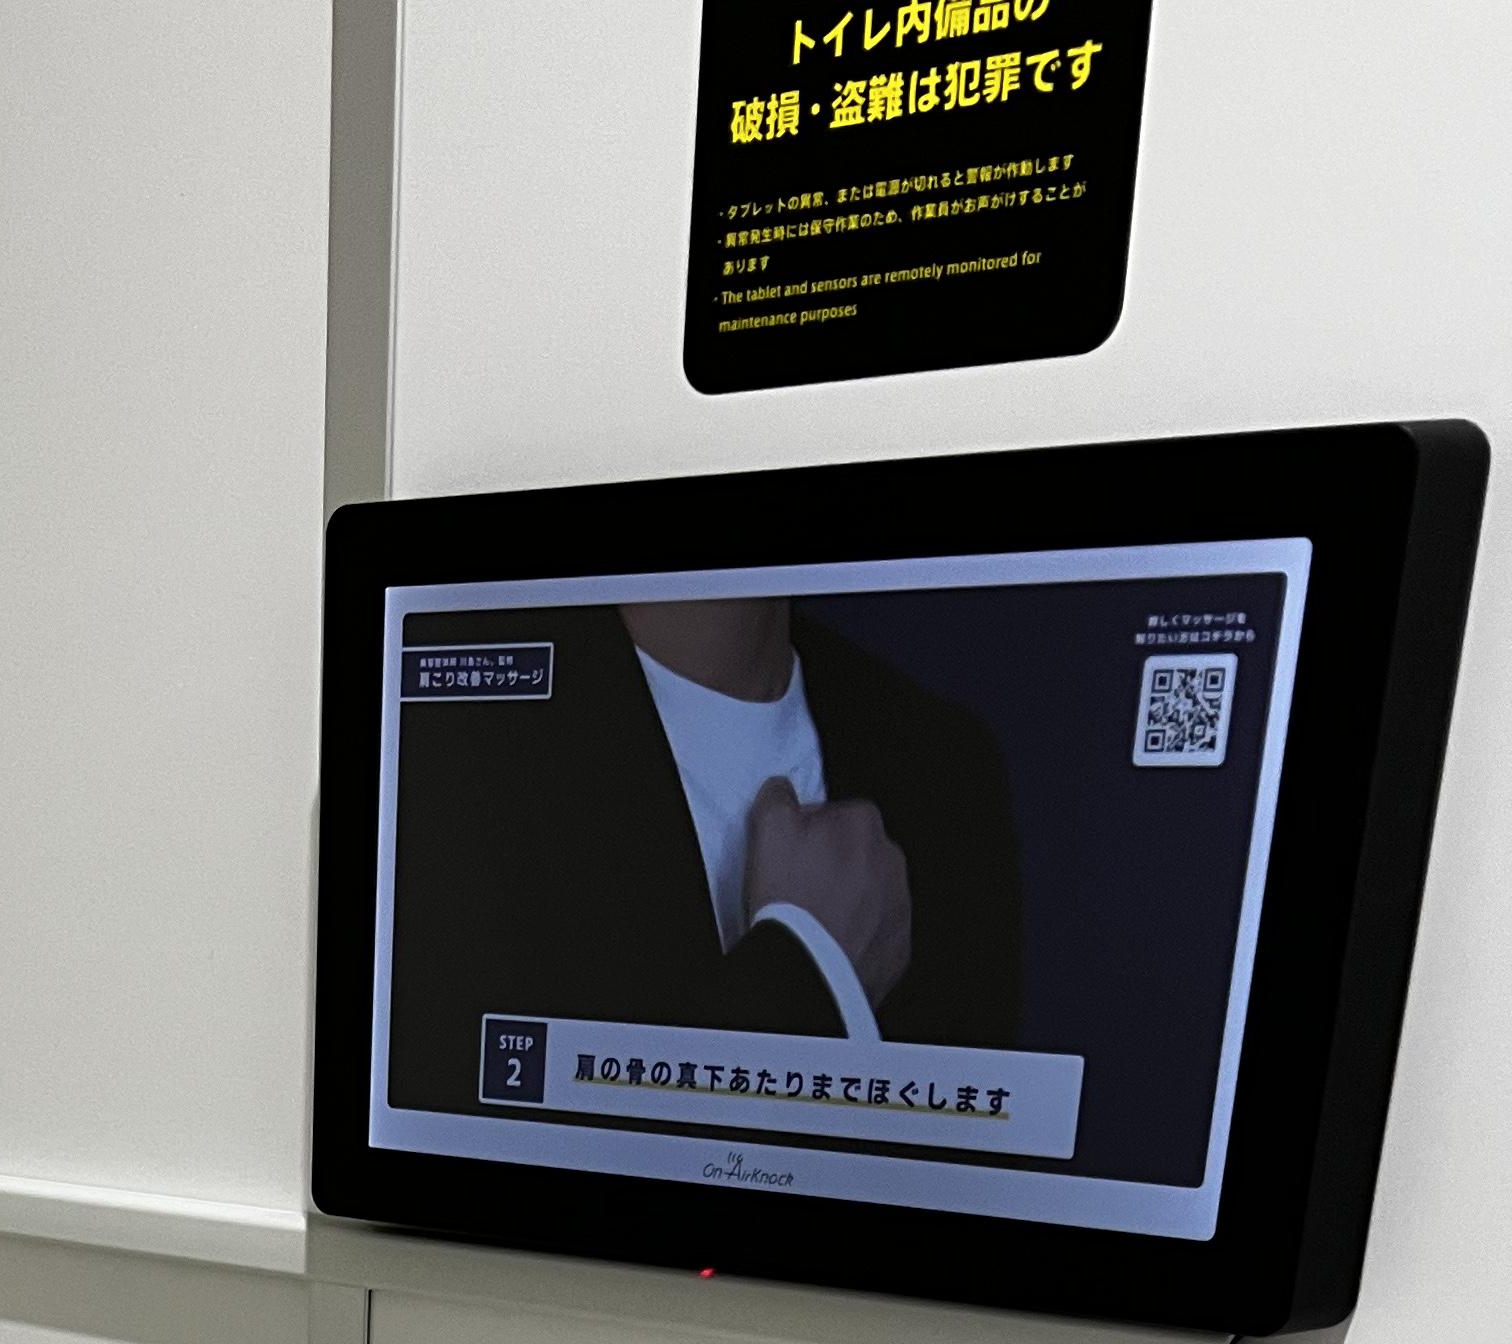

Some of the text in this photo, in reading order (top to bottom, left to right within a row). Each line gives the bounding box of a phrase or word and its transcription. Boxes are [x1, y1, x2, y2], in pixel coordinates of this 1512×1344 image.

[793, 0, 1050, 65] トイレ内備品の
[730, 39, 1104, 144] 破損・盗難は犯罪です
[723, 255, 770, 276] あります
[746, 285, 781, 302] tablet
[784, 280, 808, 297] and
[811, 276, 858, 293] sensors
[861, 273, 882, 287] are
[885, 263, 944, 285] remotely
[946, 252, 1018, 275] monitored
[1021, 250, 1042, 266] for
[719, 304, 858, 333] maintenance purposes
[499, 1034, 534, 1051] STEP
[506, 1057, 521, 1087] 2
[575, 1053, 1010, 1116] 肩の骨の真下あたりまでほぐします
